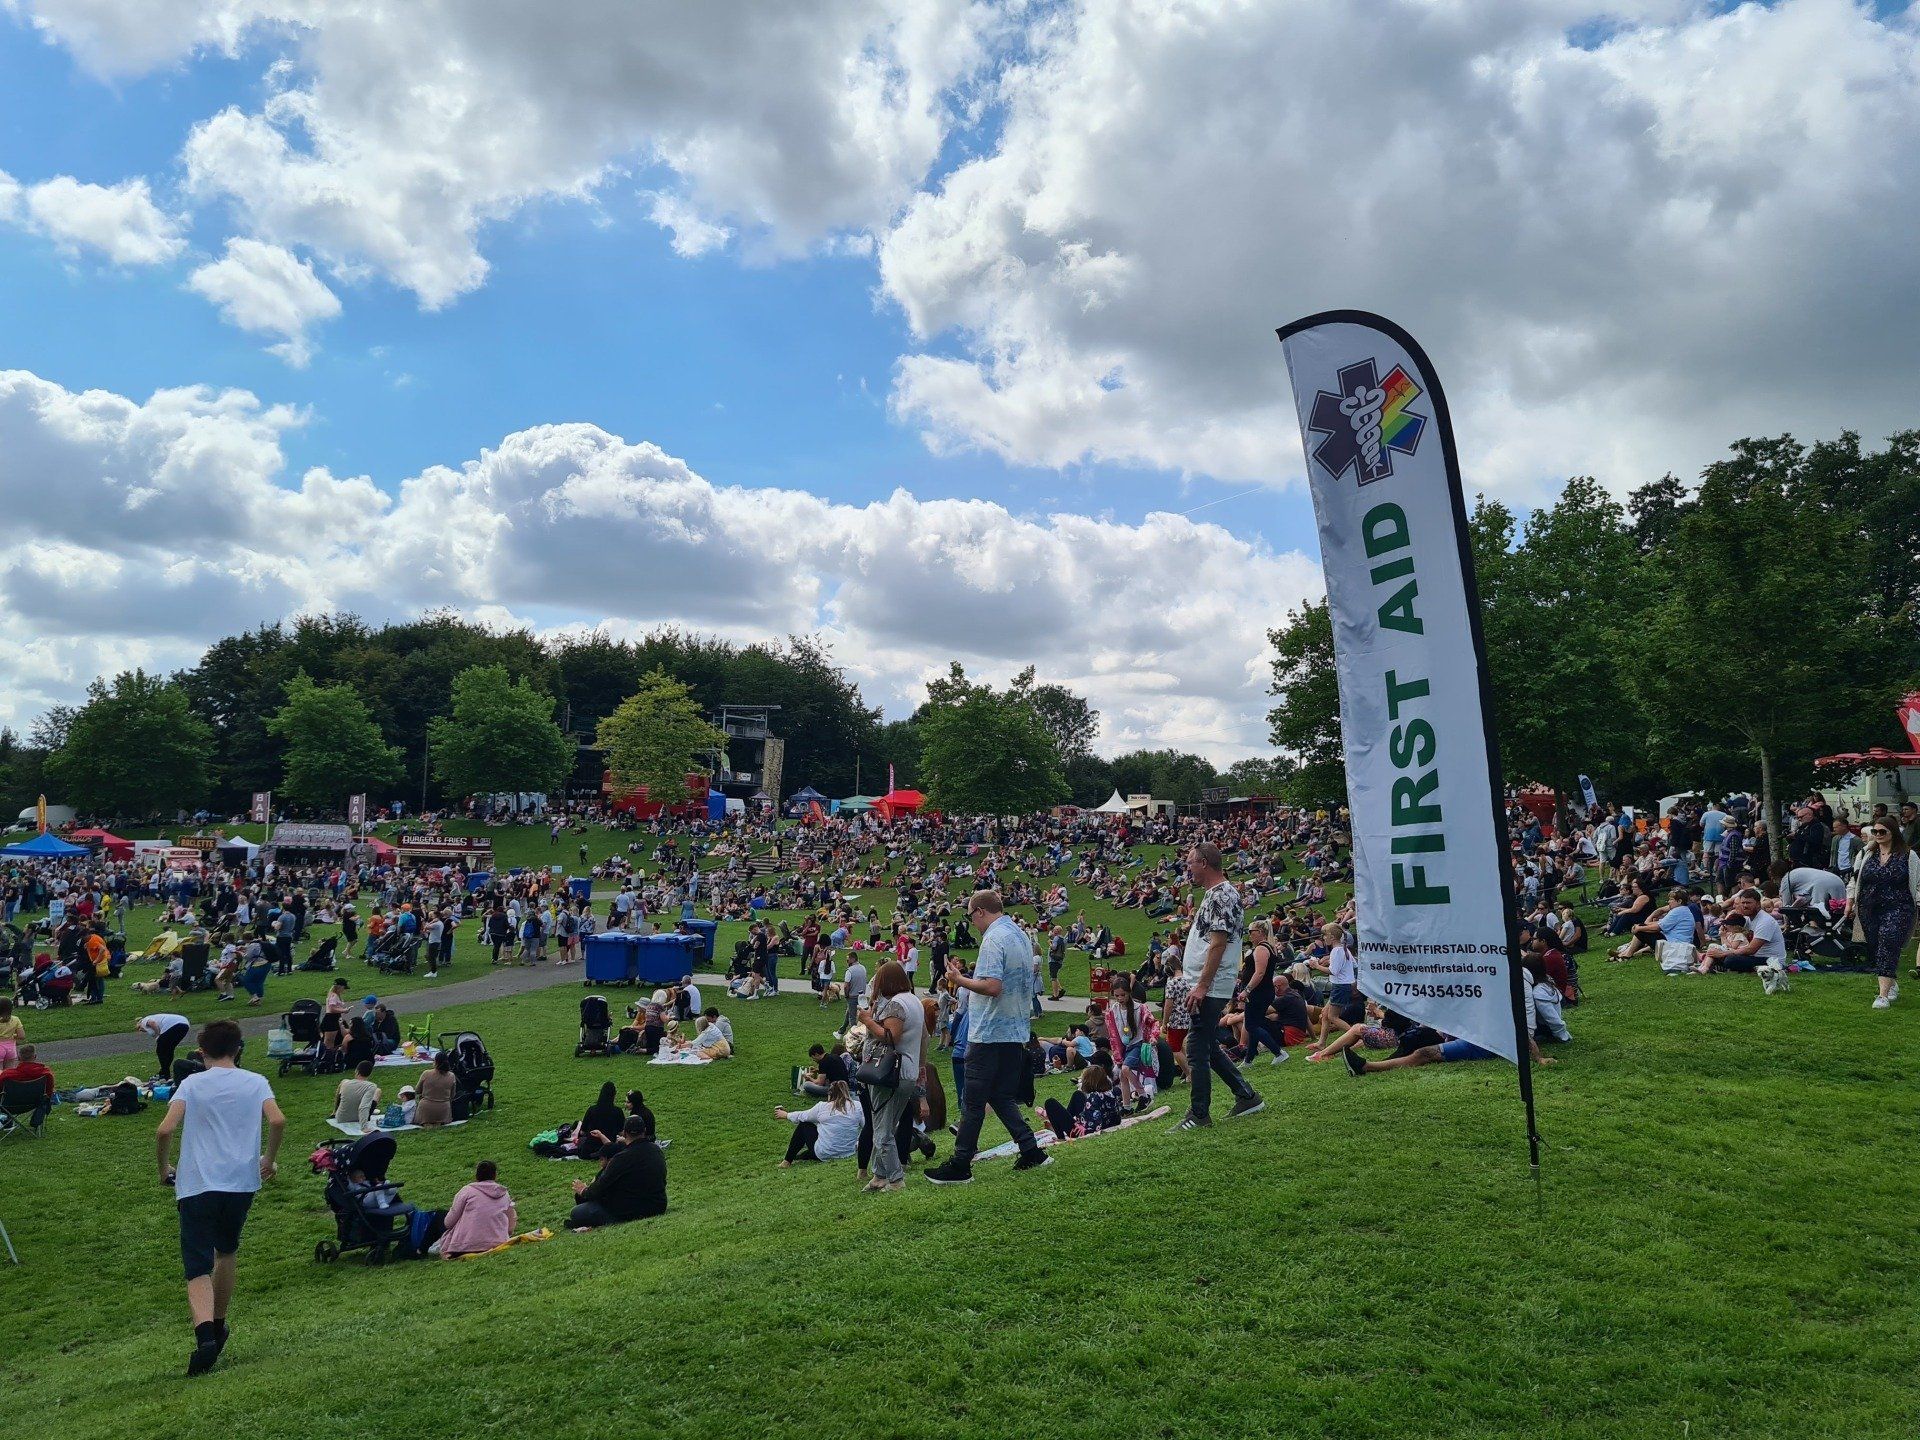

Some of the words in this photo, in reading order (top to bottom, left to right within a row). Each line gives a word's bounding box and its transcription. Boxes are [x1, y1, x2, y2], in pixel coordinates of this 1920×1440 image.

[1362, 502, 1424, 635] AID
[1384, 669, 1450, 905] FIRST
[402, 835, 434, 844] BURGER
[444, 837, 467, 846] FRIES
[1360, 942, 1508, 955] WWW.EVENTFIRSTAID.ORG
[1370, 961, 1497, 976] sales@eventfirstaid.org
[1384, 982, 1483, 998] 07754354356
